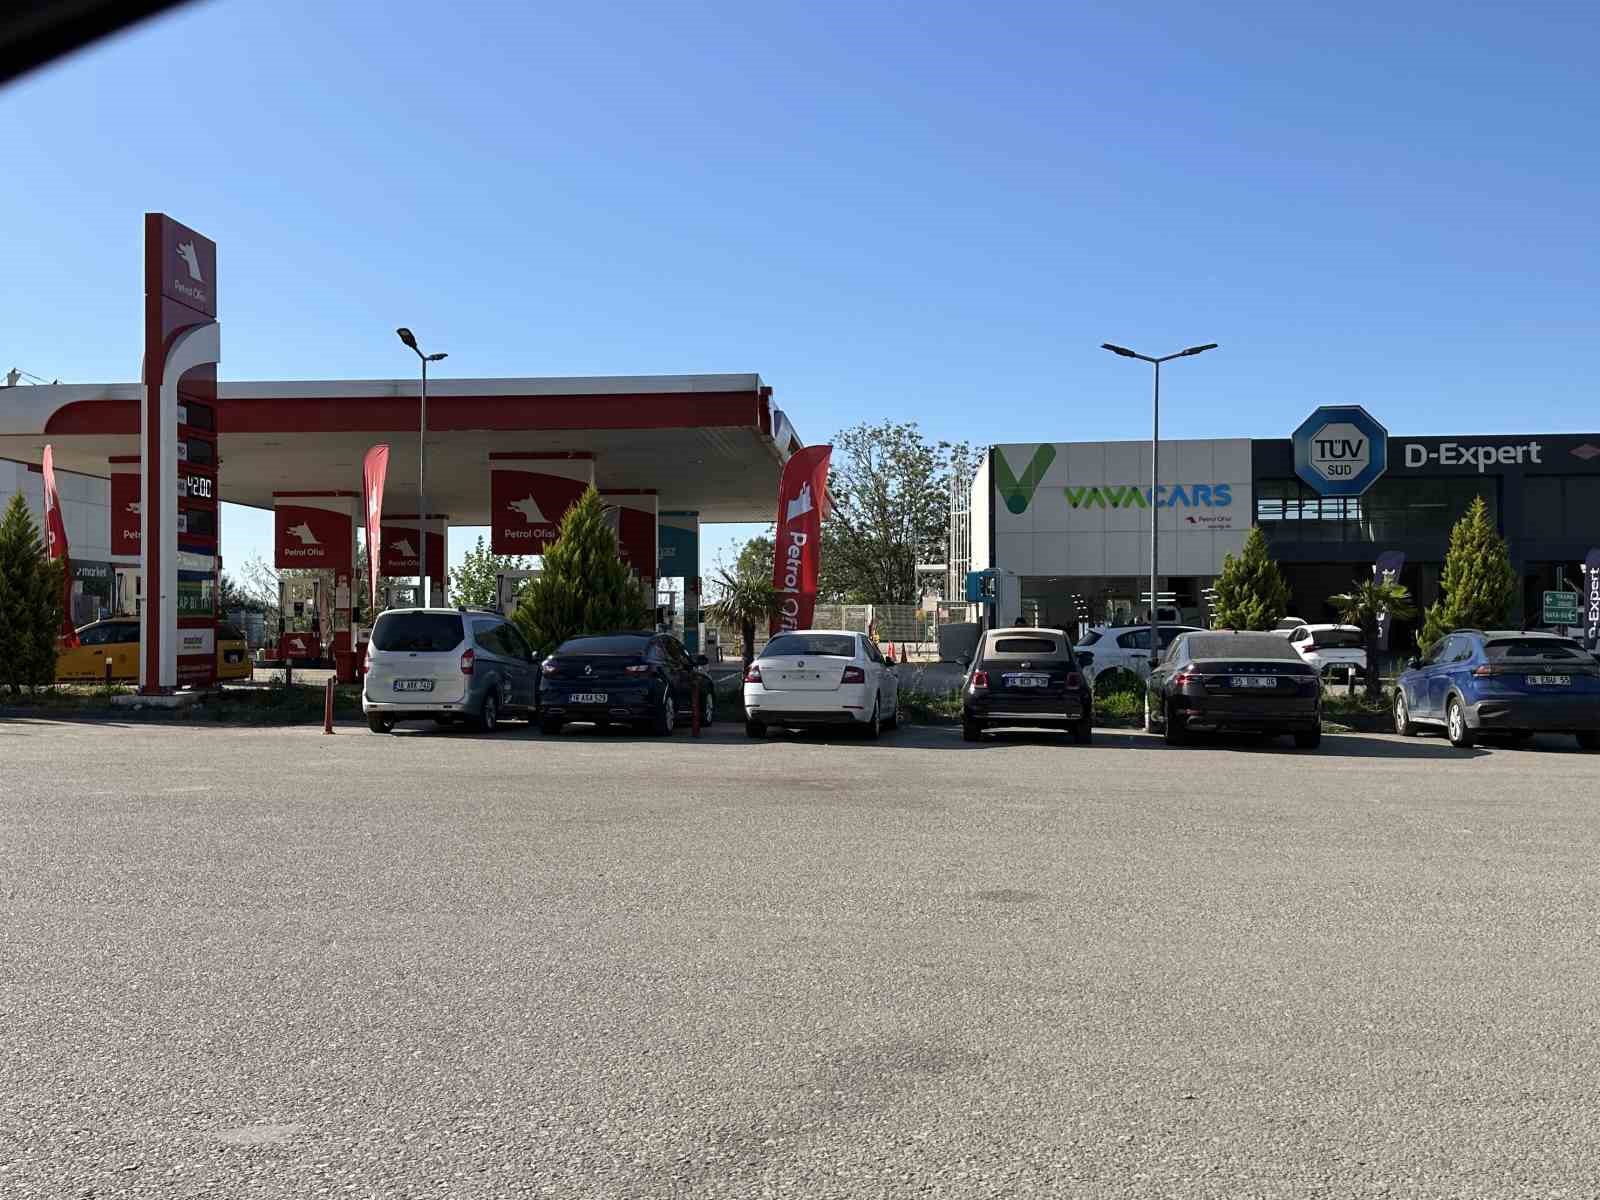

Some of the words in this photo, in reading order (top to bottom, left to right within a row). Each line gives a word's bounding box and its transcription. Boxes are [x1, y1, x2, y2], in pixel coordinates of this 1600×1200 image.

[1315, 439, 1363, 458] TÜV
[1404, 441, 1542, 472] D-Expert
[1064, 483, 1232, 509] VAVACARS
[504, 529, 532, 539] Petrol
[784, 531, 807, 593] Petrol
